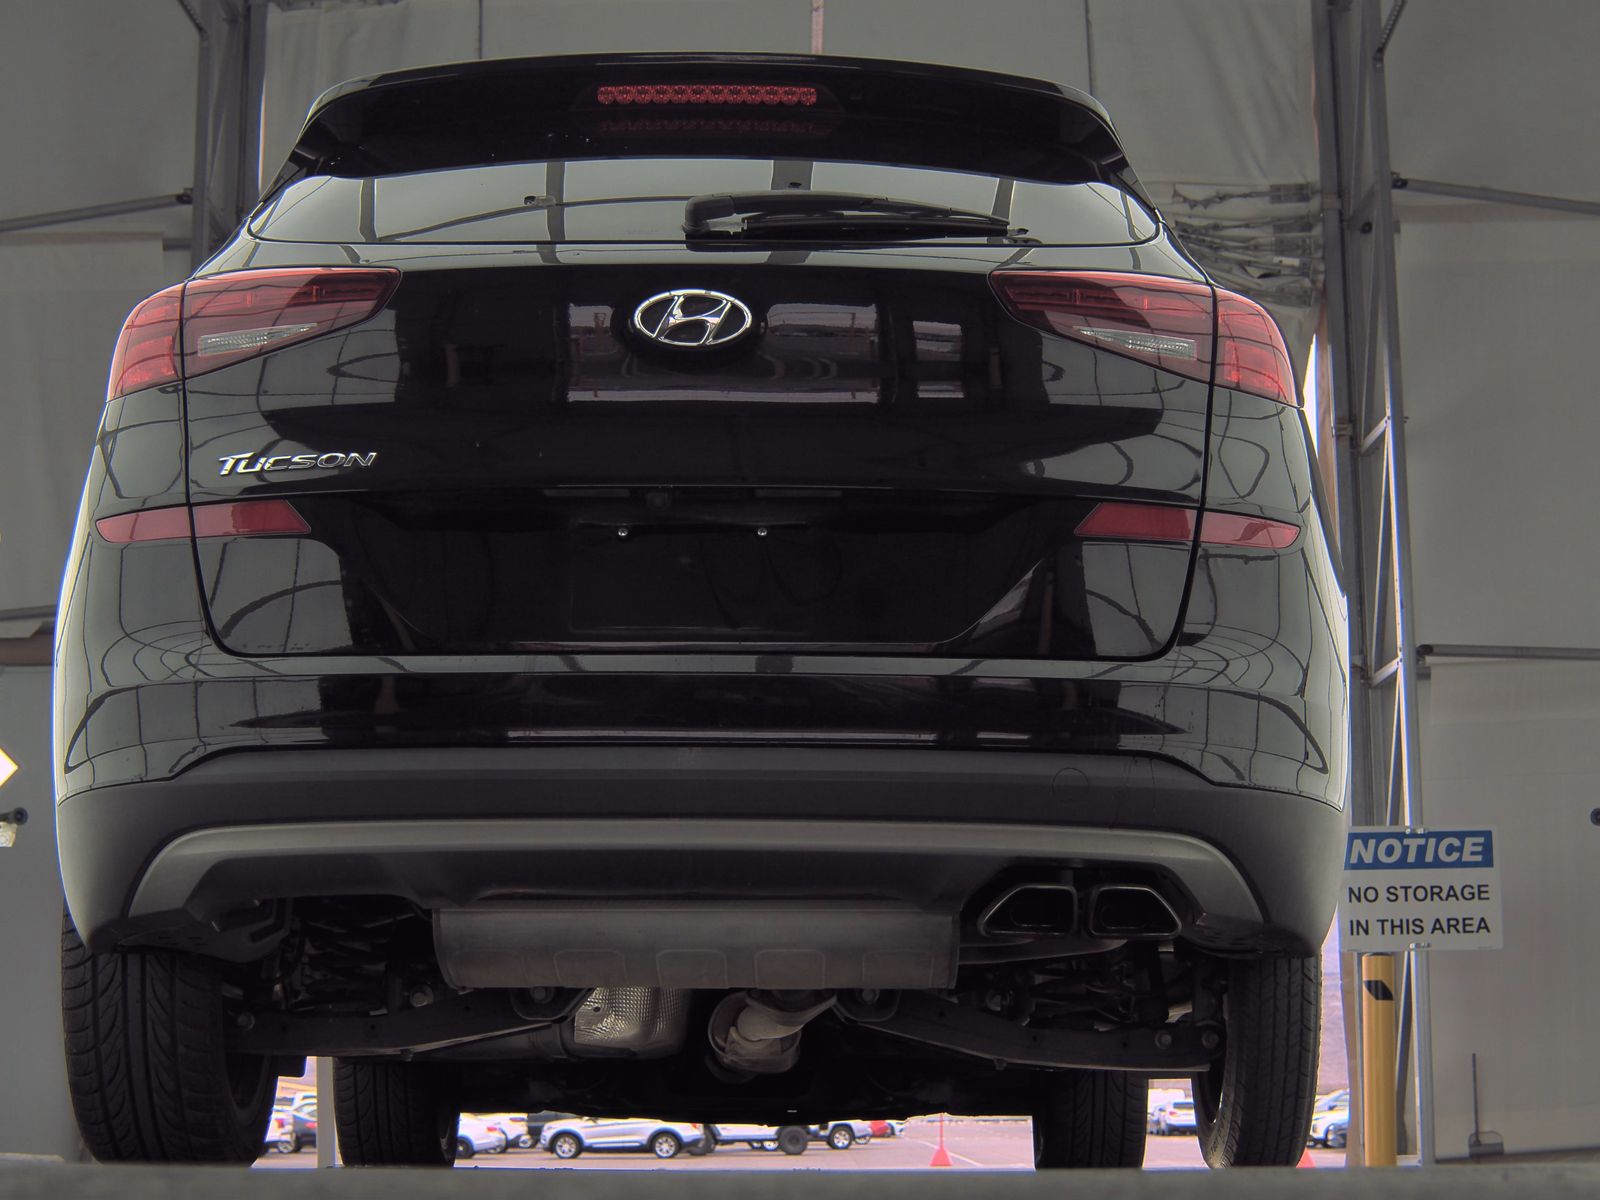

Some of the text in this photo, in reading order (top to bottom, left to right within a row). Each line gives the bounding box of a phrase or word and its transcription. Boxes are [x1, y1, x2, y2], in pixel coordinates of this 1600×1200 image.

[218, 451, 377, 476] TUCSON
[1350, 837, 1485, 864] NOTICE
[1348, 884, 1490, 903] NO STORAGE
[1350, 917, 1491, 936] IN THIS AREA
